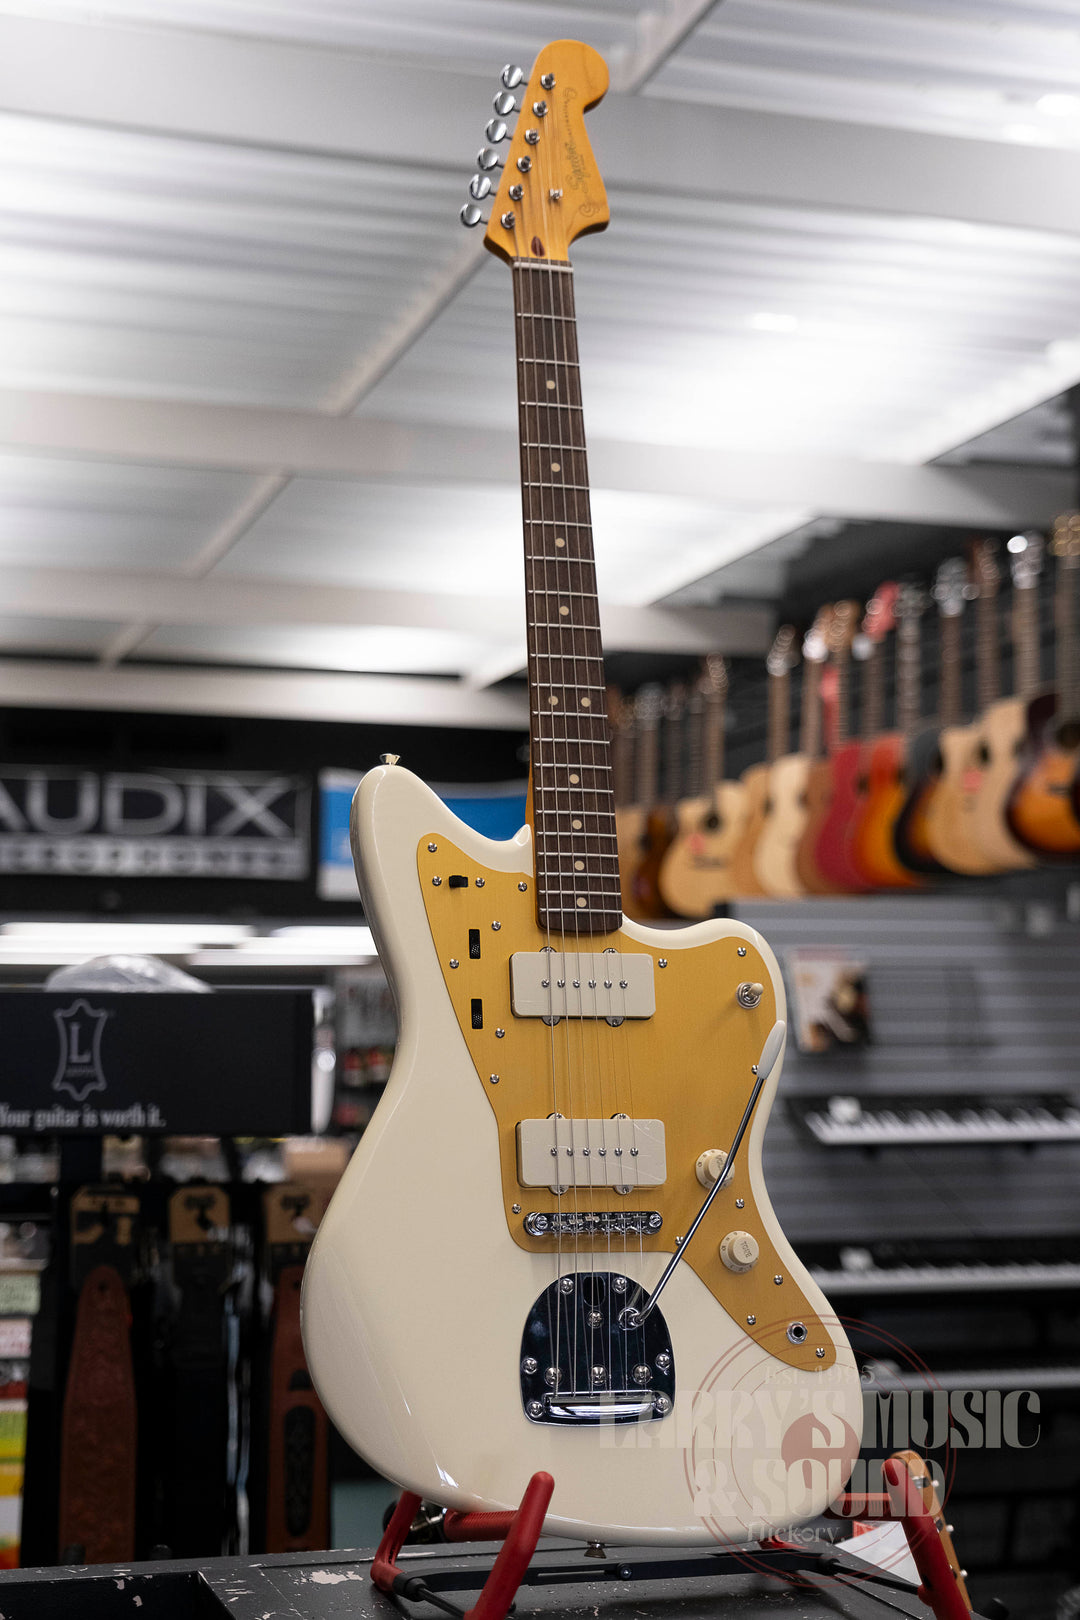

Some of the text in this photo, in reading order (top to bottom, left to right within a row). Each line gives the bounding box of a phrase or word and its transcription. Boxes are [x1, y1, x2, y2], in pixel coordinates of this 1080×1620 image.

[34, 1103, 81, 1131] guitar
[82, 1103, 98, 1127] is
[100, 1102, 146, 1127] worth
[147, 1102, 167, 1127] it.
